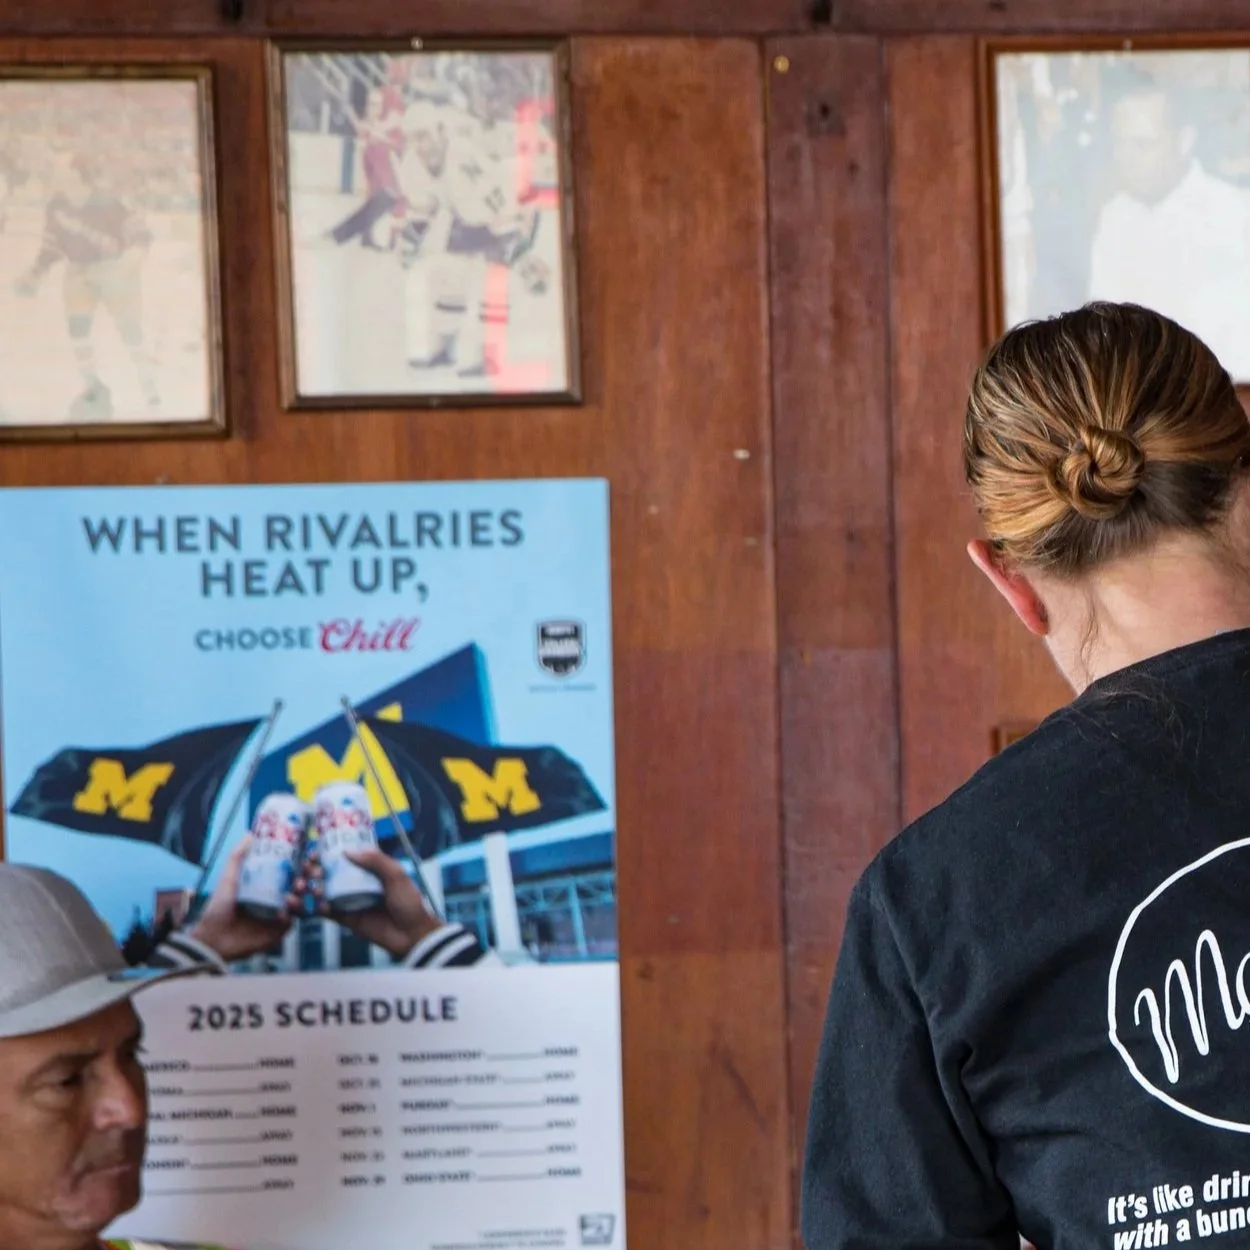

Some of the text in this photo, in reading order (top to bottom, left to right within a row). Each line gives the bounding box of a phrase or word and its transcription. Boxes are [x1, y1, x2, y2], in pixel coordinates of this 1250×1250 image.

[82, 510, 524, 554] WHEN RIVALRIES
[201, 556, 429, 602] HEAT UP,
[195, 616, 420, 653] CHOOSE Chill
[73, 758, 174, 821] M
[441, 758, 541, 822] M
[188, 996, 459, 1031] 2025 SCHEDULE
[1107, 1197, 1147, 1225] It's
[1153, 1183, 1194, 1215] like
[1176, 1221, 1191, 1242] a
